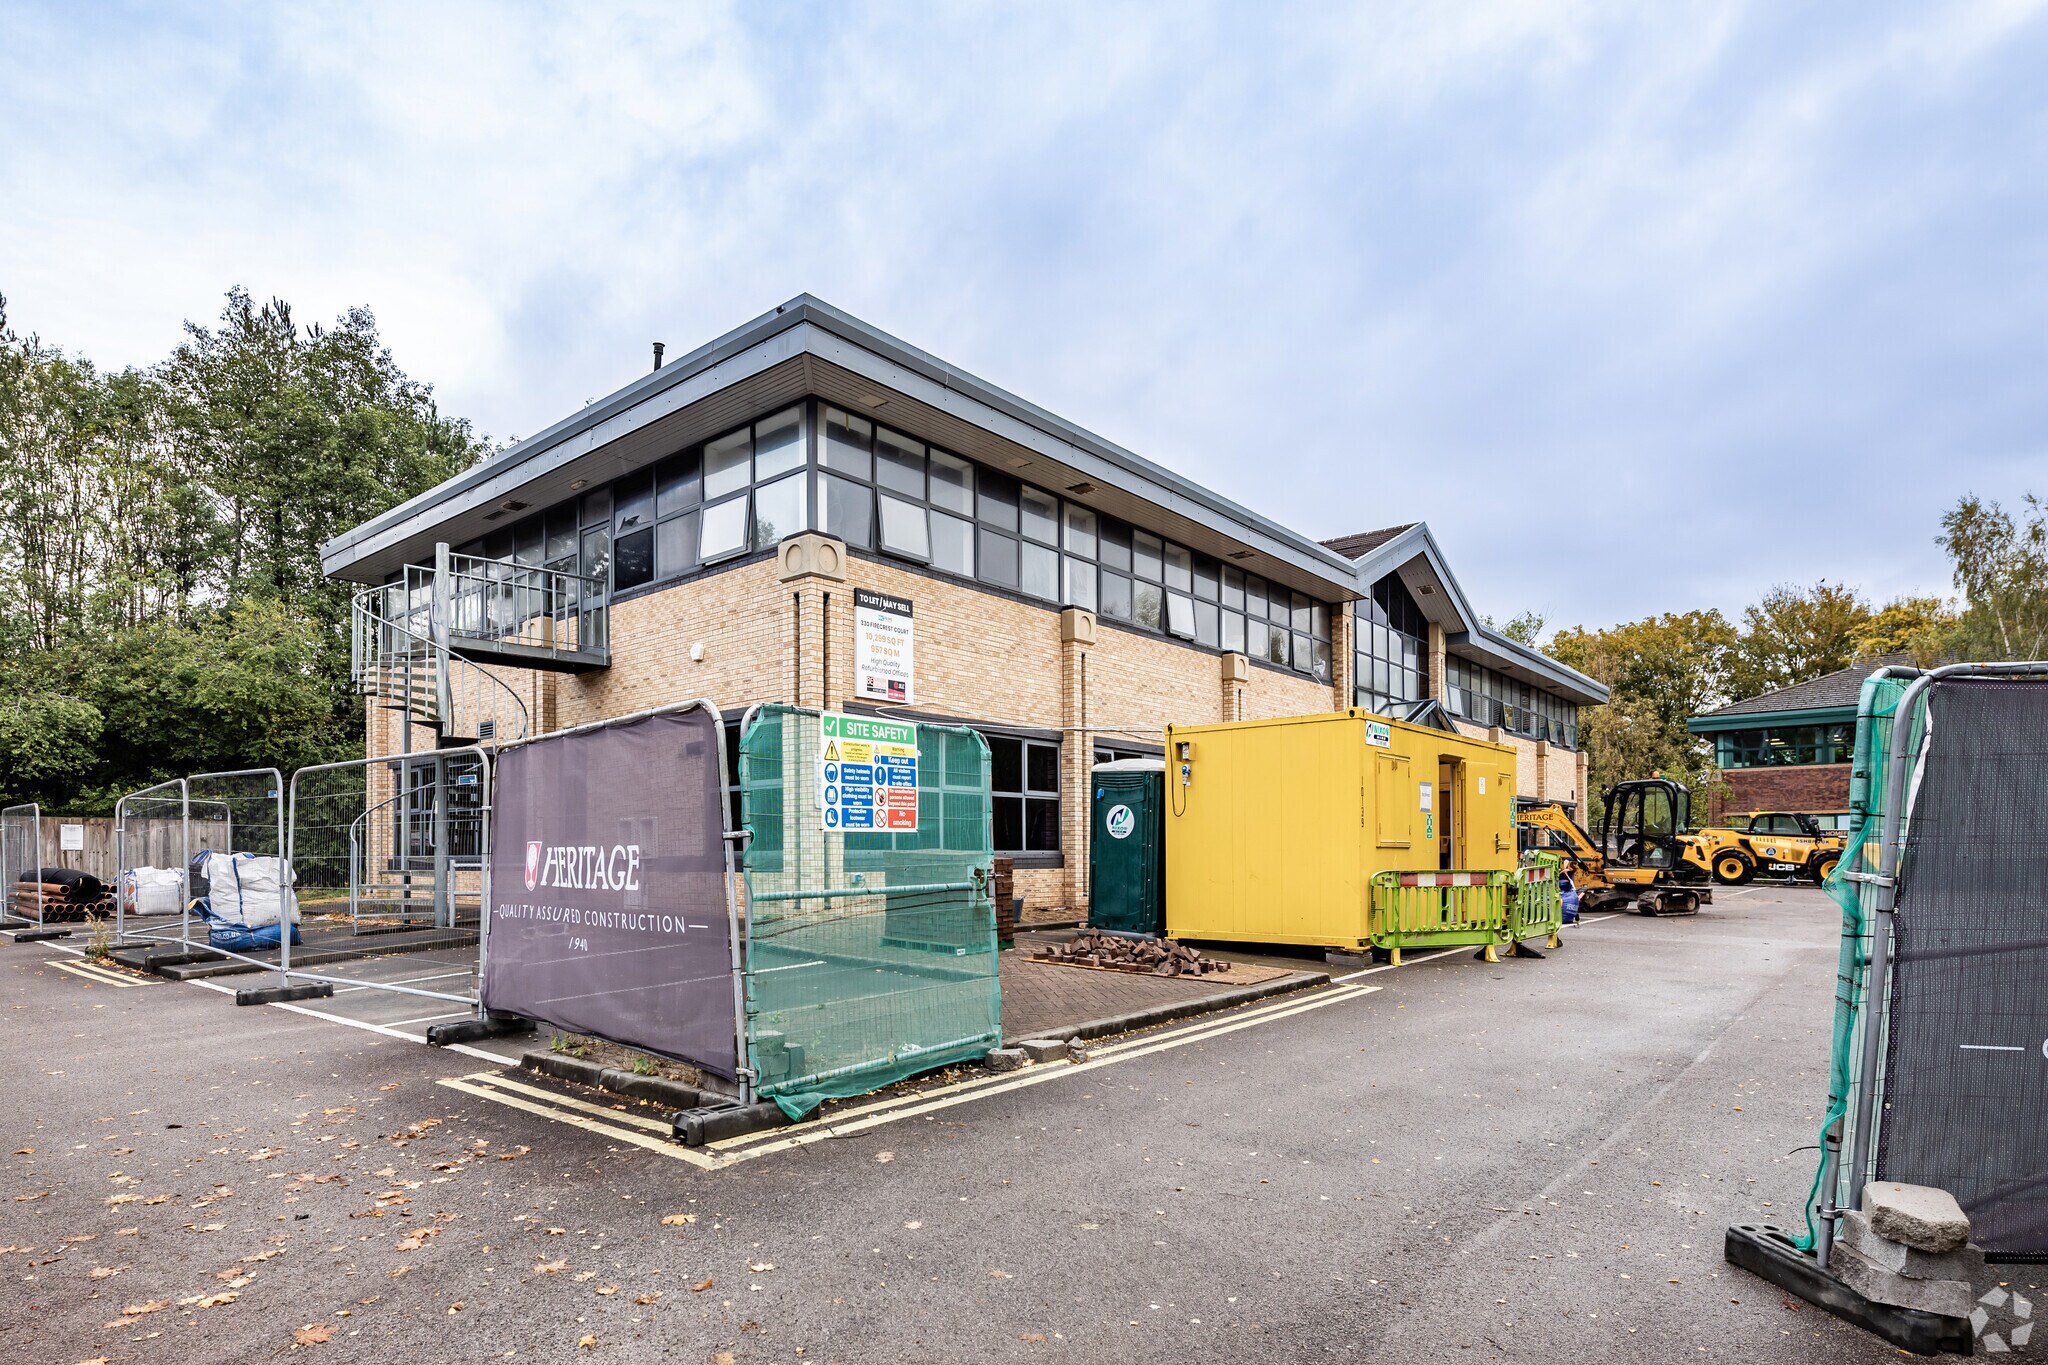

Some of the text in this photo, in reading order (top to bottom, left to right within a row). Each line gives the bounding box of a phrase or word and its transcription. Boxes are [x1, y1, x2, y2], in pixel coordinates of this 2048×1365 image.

[860, 594, 868, 602] TO
[869, 596, 879, 606] LET
[883, 600, 897, 609] MAY
[897, 603, 910, 612] SELL
[870, 622, 893, 631] FIRECREST
[894, 627, 909, 635] COURT
[887, 636, 896, 646] SQ
[884, 647, 893, 657] SQ
[871, 657, 900, 669] High Quality
[862, 664, 909, 678] Refurbished Offices
[847, 722, 908, 741] SITE SAFETY
[888, 757, 900, 765] Keep
[540, 845, 639, 891] HERITAGE
[499, 904, 686, 933] QUALITY ASSURED CONSTRUCTION
